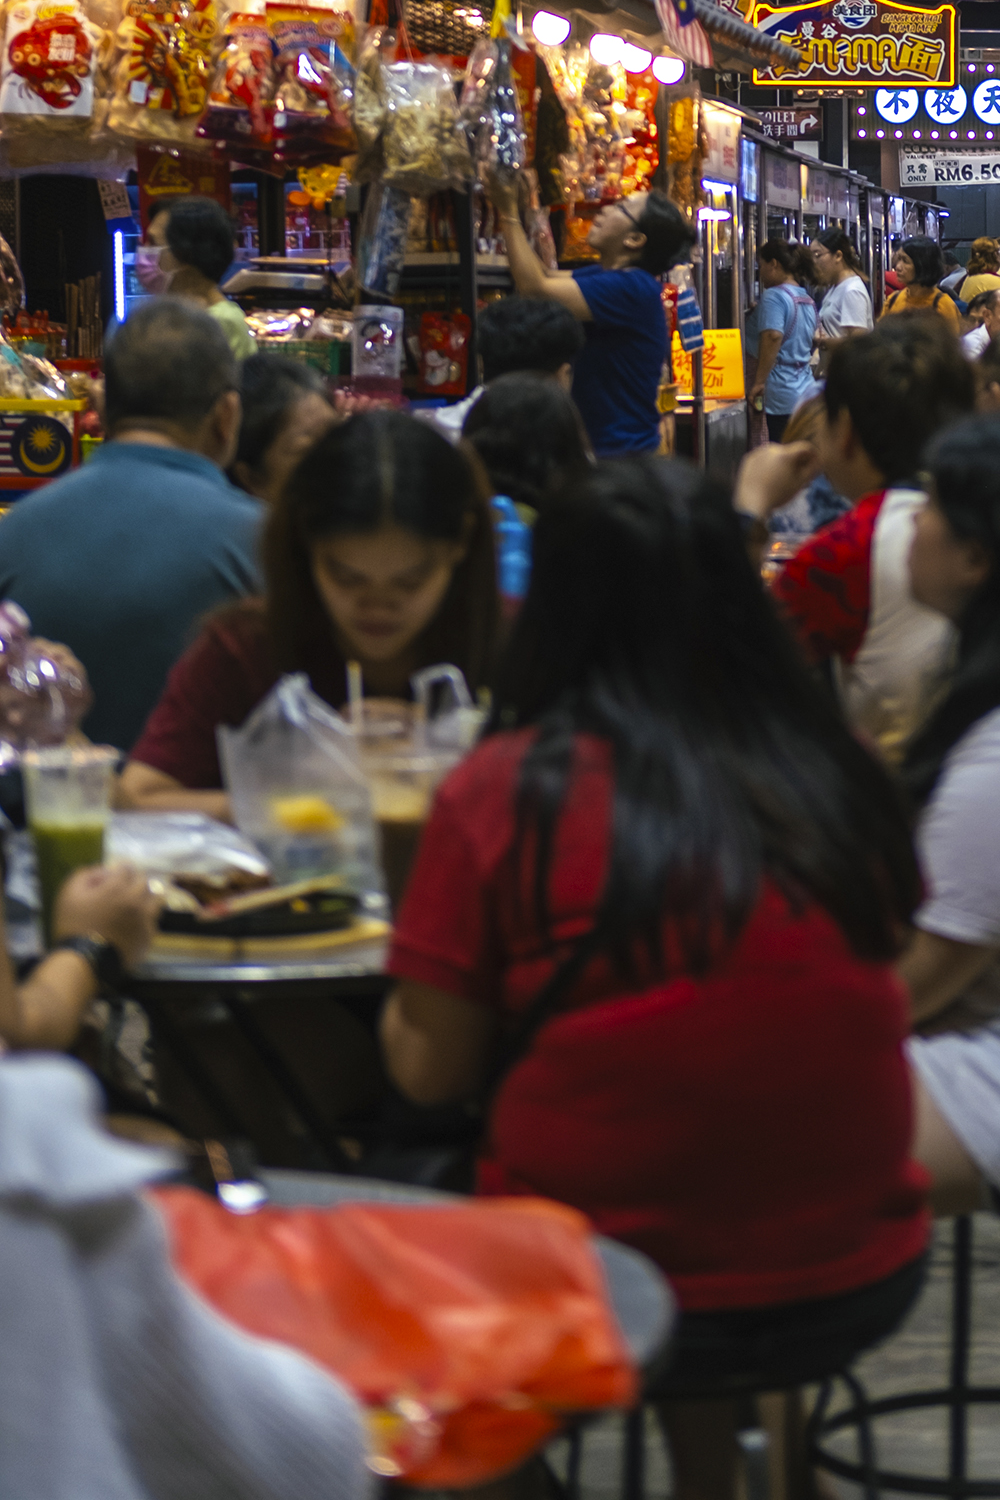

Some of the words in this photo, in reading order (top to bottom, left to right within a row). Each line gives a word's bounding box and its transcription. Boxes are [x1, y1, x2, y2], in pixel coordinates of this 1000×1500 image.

[881, 13, 923, 25] BANGKOK
[888, 23, 915, 34] MAMA
[907, 174, 928, 183] ONLY
